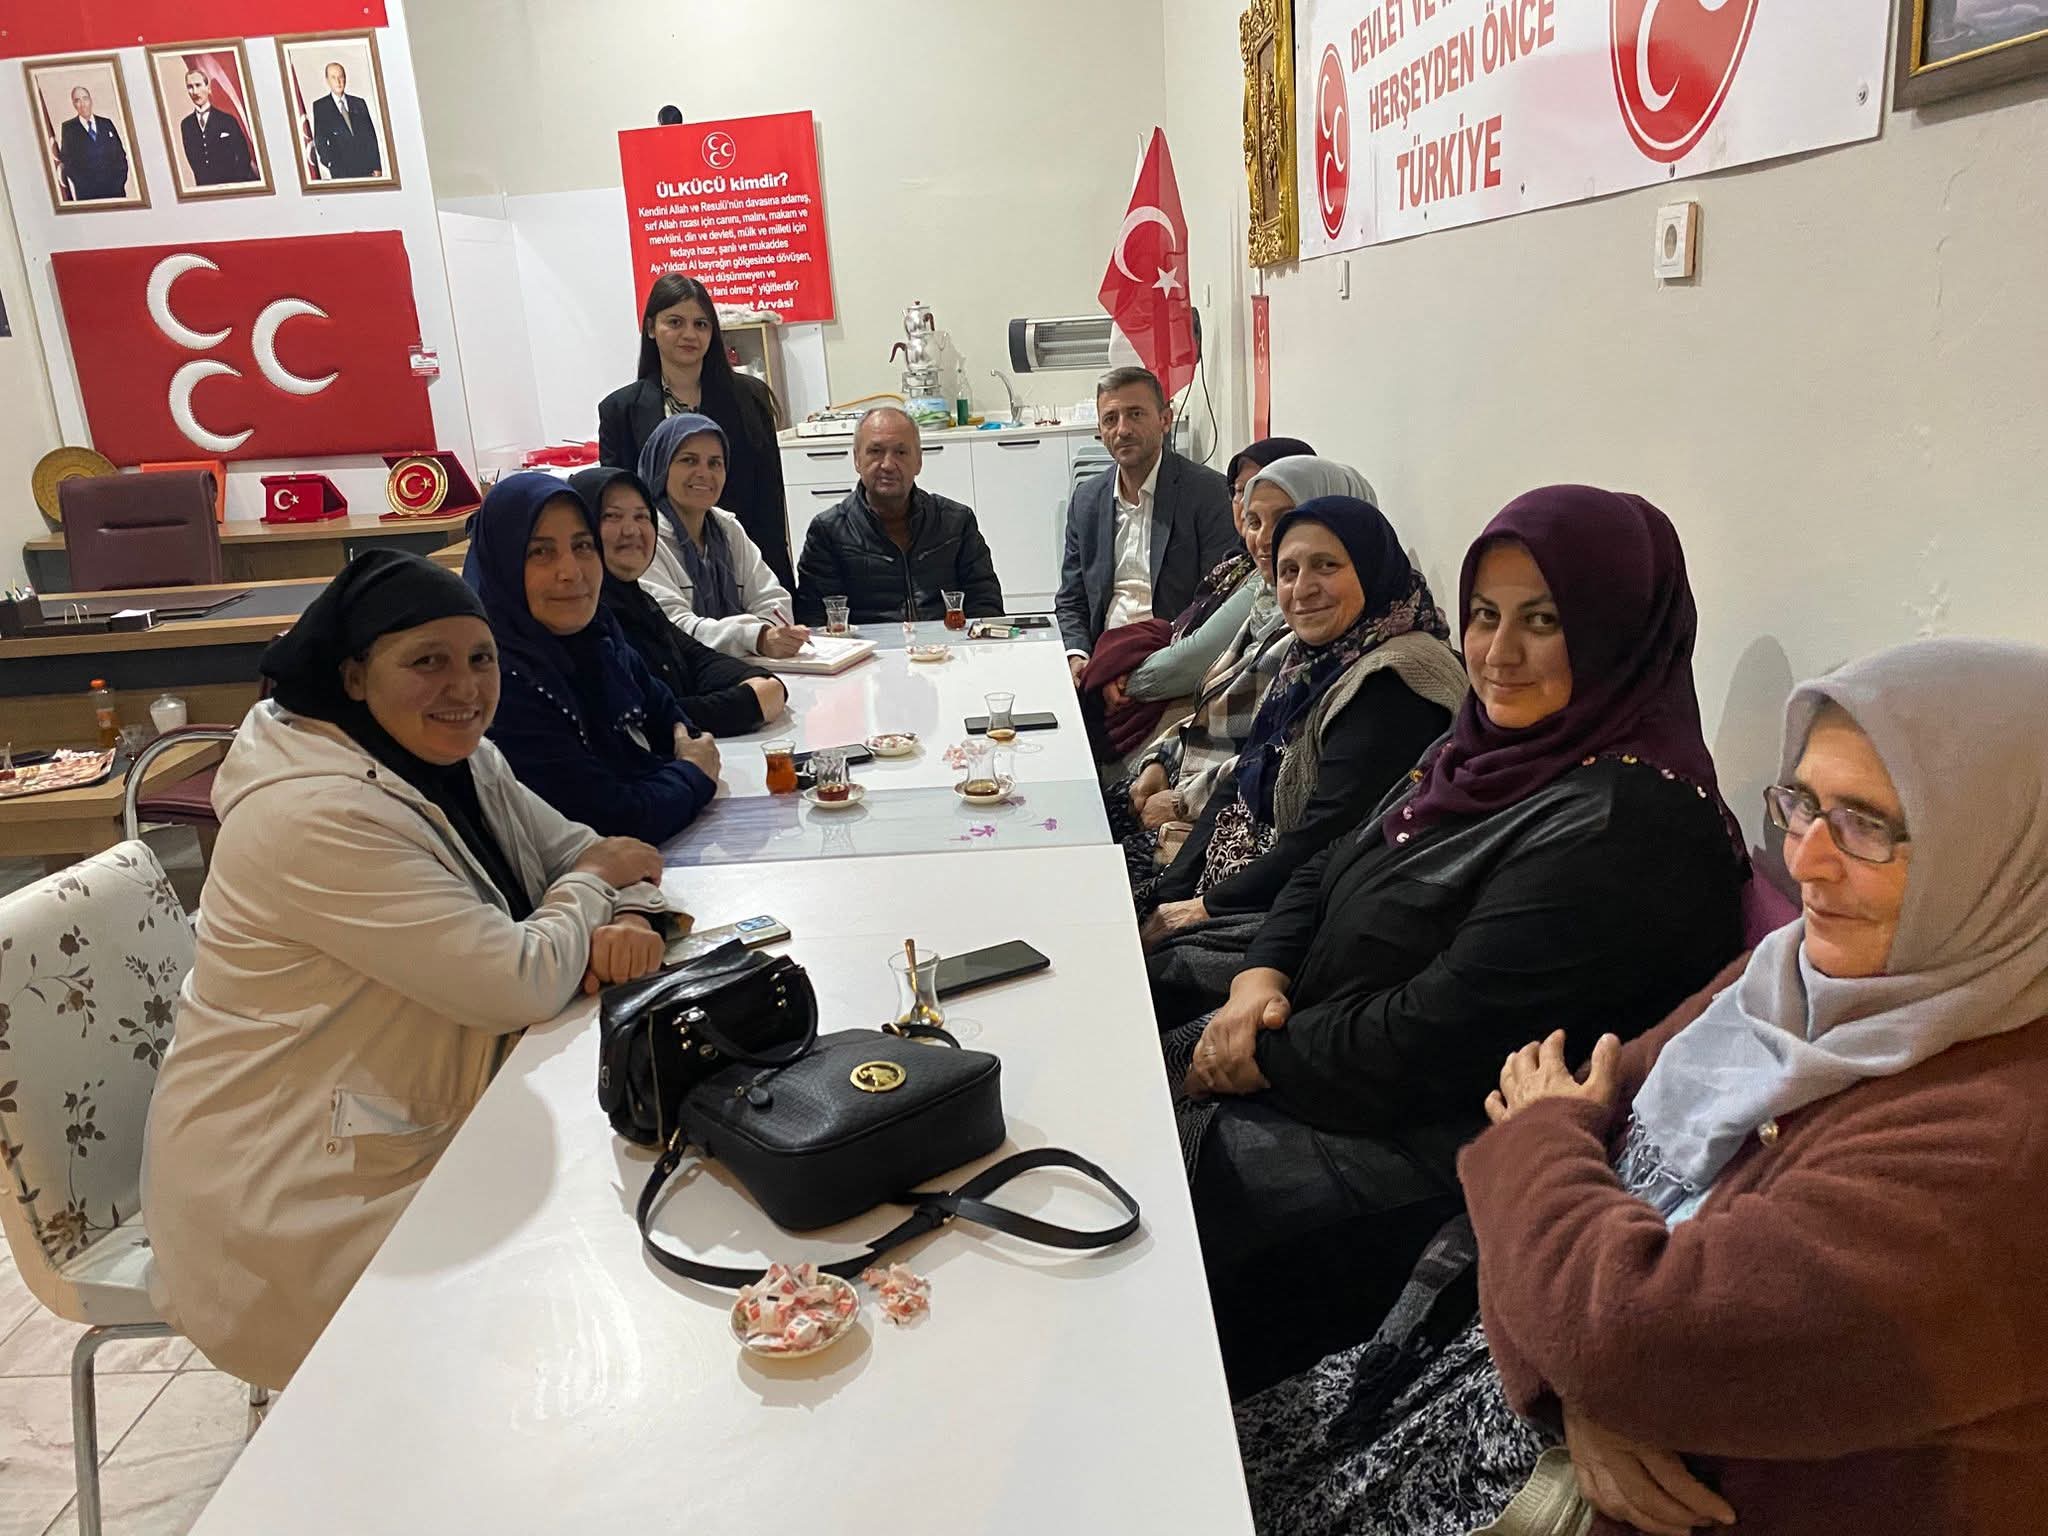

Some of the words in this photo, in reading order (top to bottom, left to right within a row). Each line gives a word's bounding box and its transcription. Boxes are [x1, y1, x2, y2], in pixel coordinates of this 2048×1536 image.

[1351, 0, 1404, 73] DEVLET
[1369, 26, 1475, 132] HERŞEYDEN
[1482, 0, 1555, 75] ÖNCE
[1396, 113, 1502, 211] TÜRKİYE
[656, 176, 726, 198] ÜLKÜCÜ
[730, 172, 789, 192] kimdir?
[639, 205, 668, 218] Kendini
[669, 203, 689, 215] Allah
[690, 204, 700, 212] ve
[700, 199, 745, 212] Resulü'nün
[746, 196, 780, 208] davasına
[781, 194, 811, 205] adamış,
[644, 221, 658, 232] sırf
[658, 219, 678, 231] Allah
[679, 217, 700, 228] rızası
[701, 215, 715, 227] için
[716, 213, 742, 226] canını,
[743, 211, 768, 224] malını,
[769, 208, 798, 220] makam
[799, 208, 808, 217] ve
[684, 231, 697, 243] din
[698, 232, 708, 241] ve
[709, 228, 736, 241] devleti,
[737, 226, 757, 238] mülk
[758, 227, 767, 235] ve
[768, 223, 791, 236] milleti
[792, 222, 807, 235] için
[670, 246, 696, 259] fedaya
[697, 244, 718, 256] hazır,
[718, 242, 737, 255] şanlı
[738, 243, 748, 251] ve
[749, 239, 789, 251] mukaddes
[688, 258, 697, 270] Al
[698, 256, 732, 271] bayrağın
[733, 253, 775, 269] gölgesinde
[776, 251, 812, 264] dövüşen,
[715, 270, 765, 283] düşünmeyen
[766, 269, 776, 278] ve
[713, 285, 728, 296] fani
[758, 279, 799, 295] yiğitlerdir?
[757, 297, 794, 310] Arvâsi
